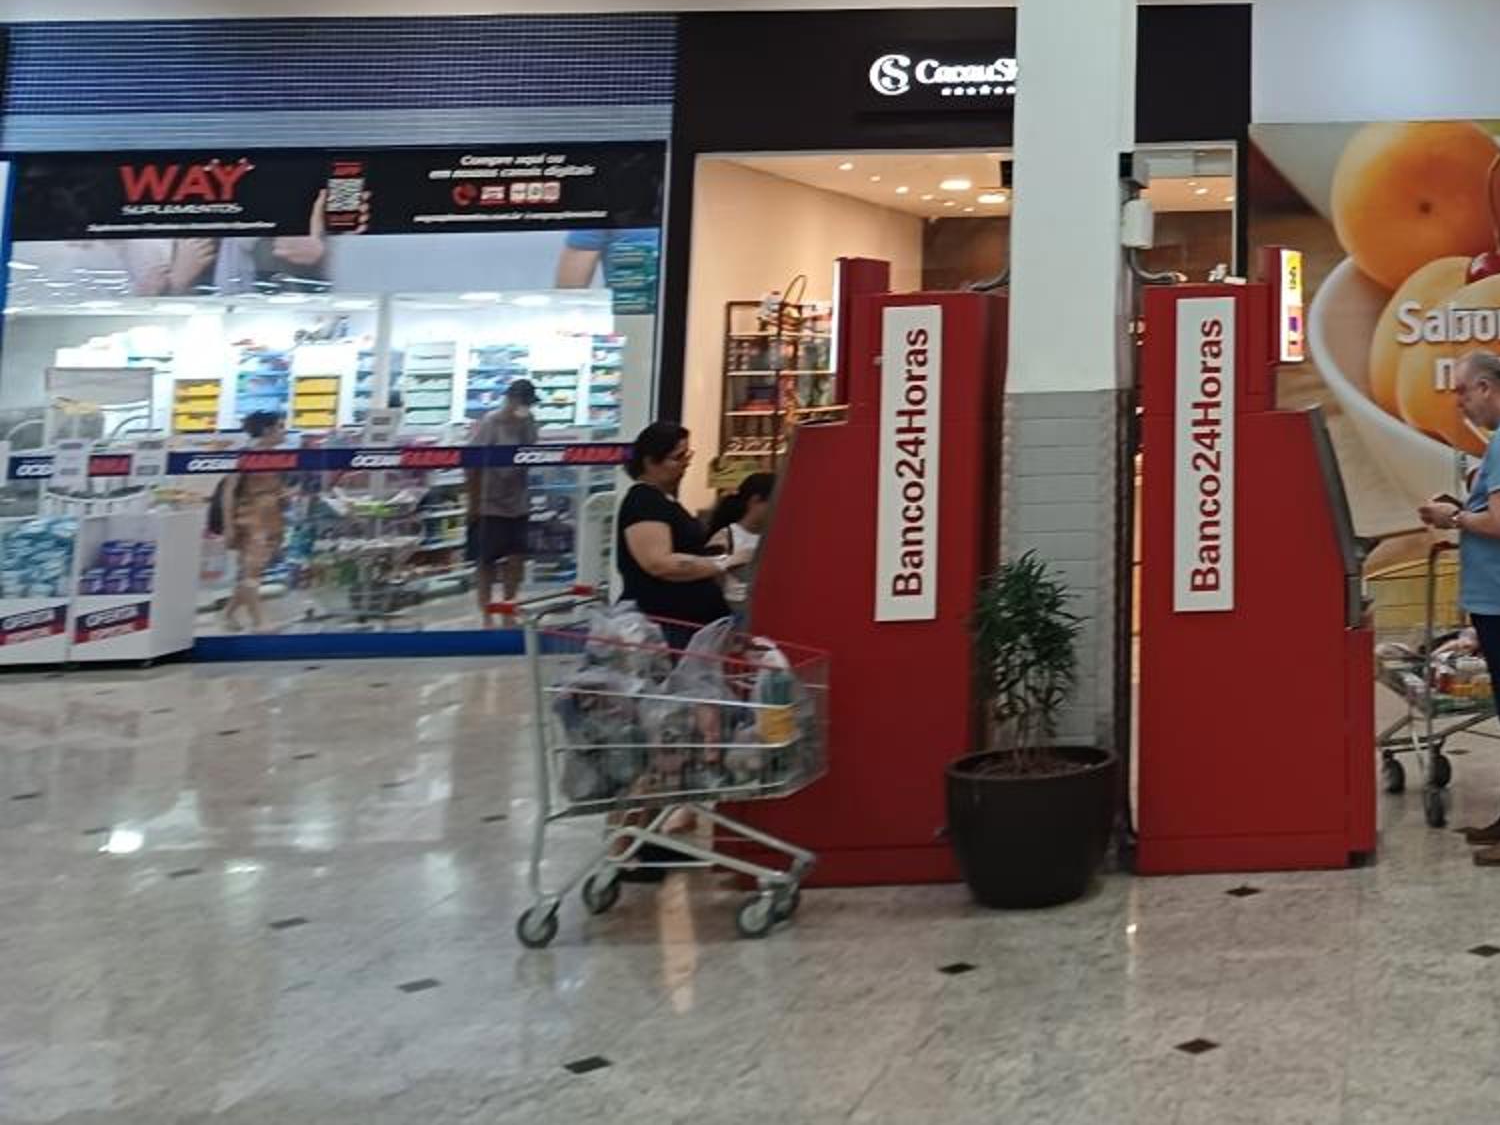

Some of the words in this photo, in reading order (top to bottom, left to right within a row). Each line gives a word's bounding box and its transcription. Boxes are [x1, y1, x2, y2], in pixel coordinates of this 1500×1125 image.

[119, 159, 253, 203] WAY
[892, 328, 929, 597] Banco24Horas
[1189, 318, 1223, 592] Banco24Horas
